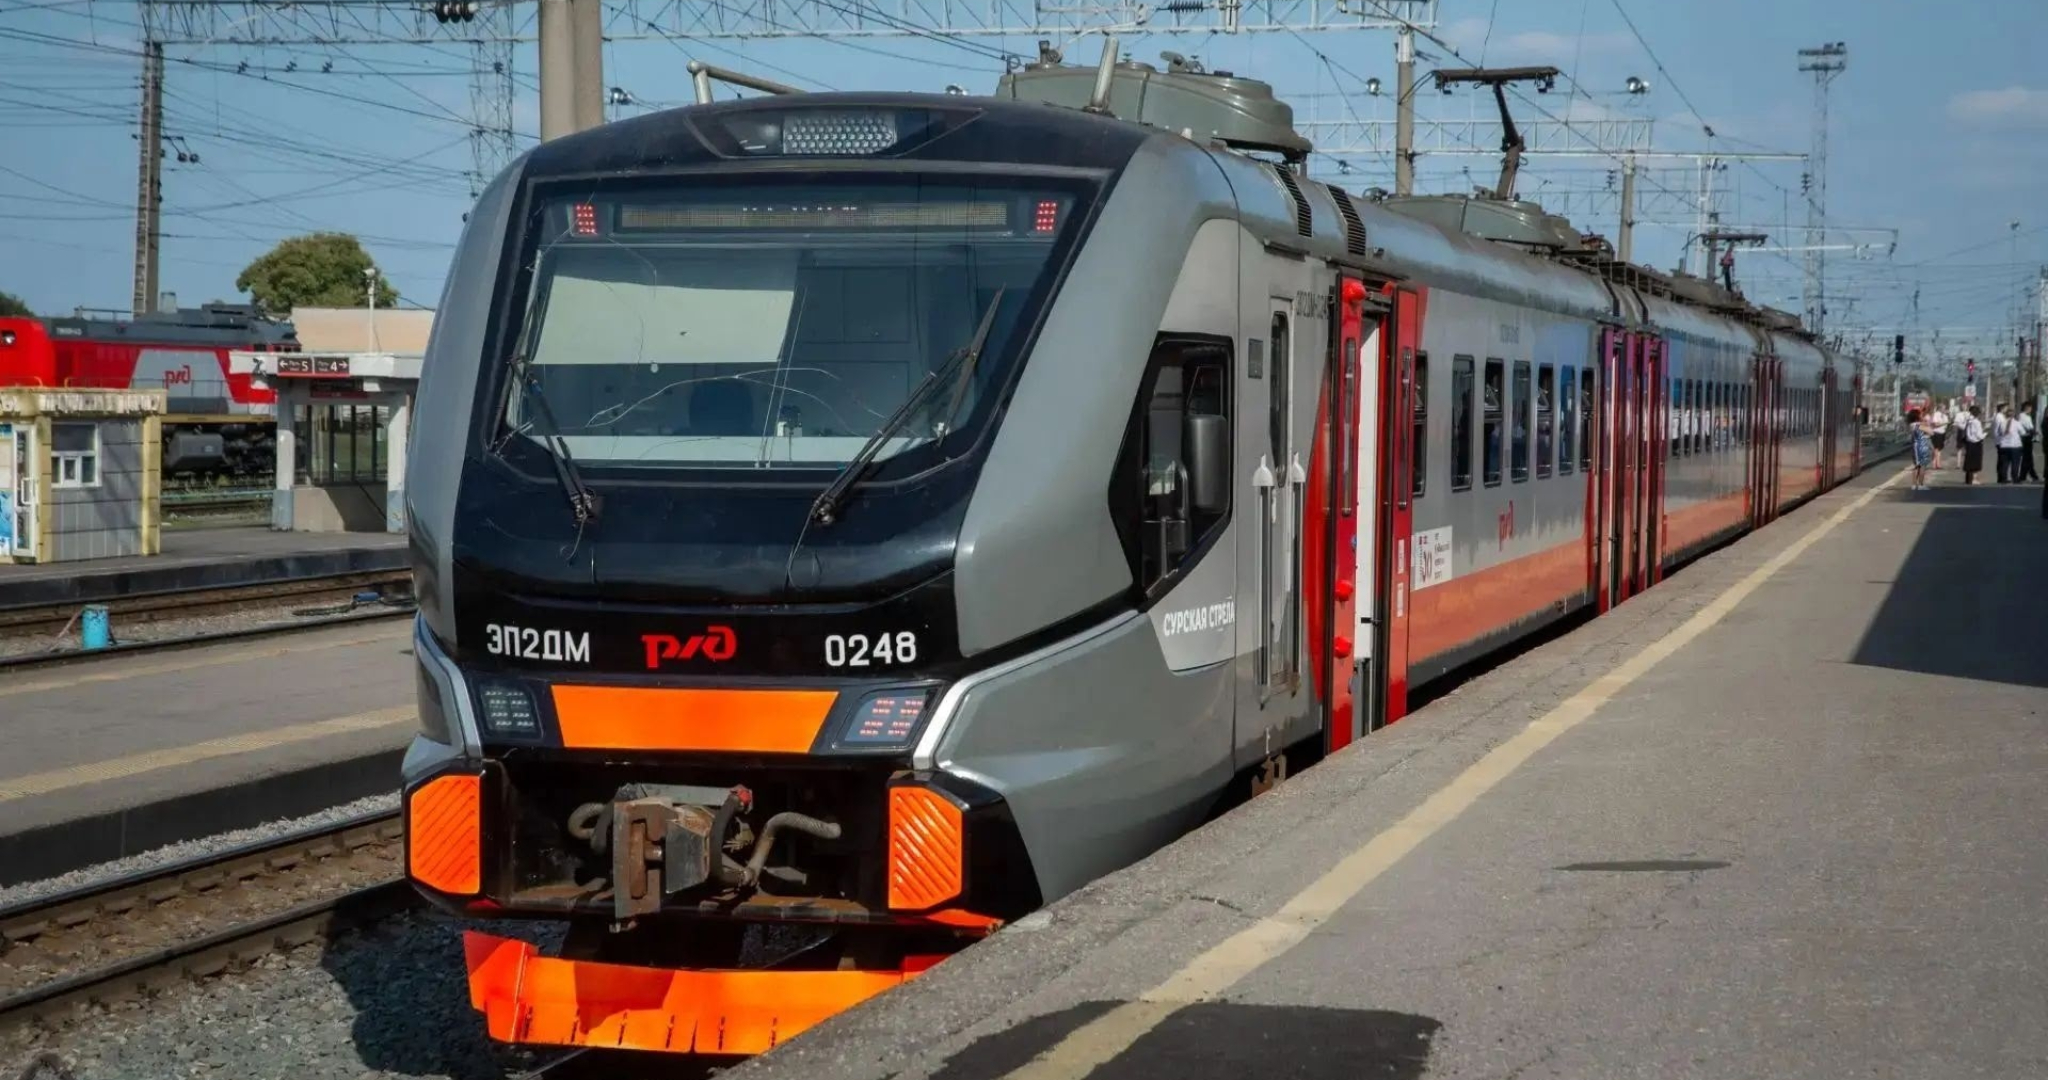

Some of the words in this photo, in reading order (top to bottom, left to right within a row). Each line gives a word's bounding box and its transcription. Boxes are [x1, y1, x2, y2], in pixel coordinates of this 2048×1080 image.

[302, 361, 309, 372] 5
[330, 361, 338, 372] 4
[1164, 606, 1207, 637] СУРСКАЯ
[1209, 601, 1235, 628] СТРЕЛА
[486, 623, 590, 663] ЭП2ДМ
[825, 631, 916, 666] 0248
